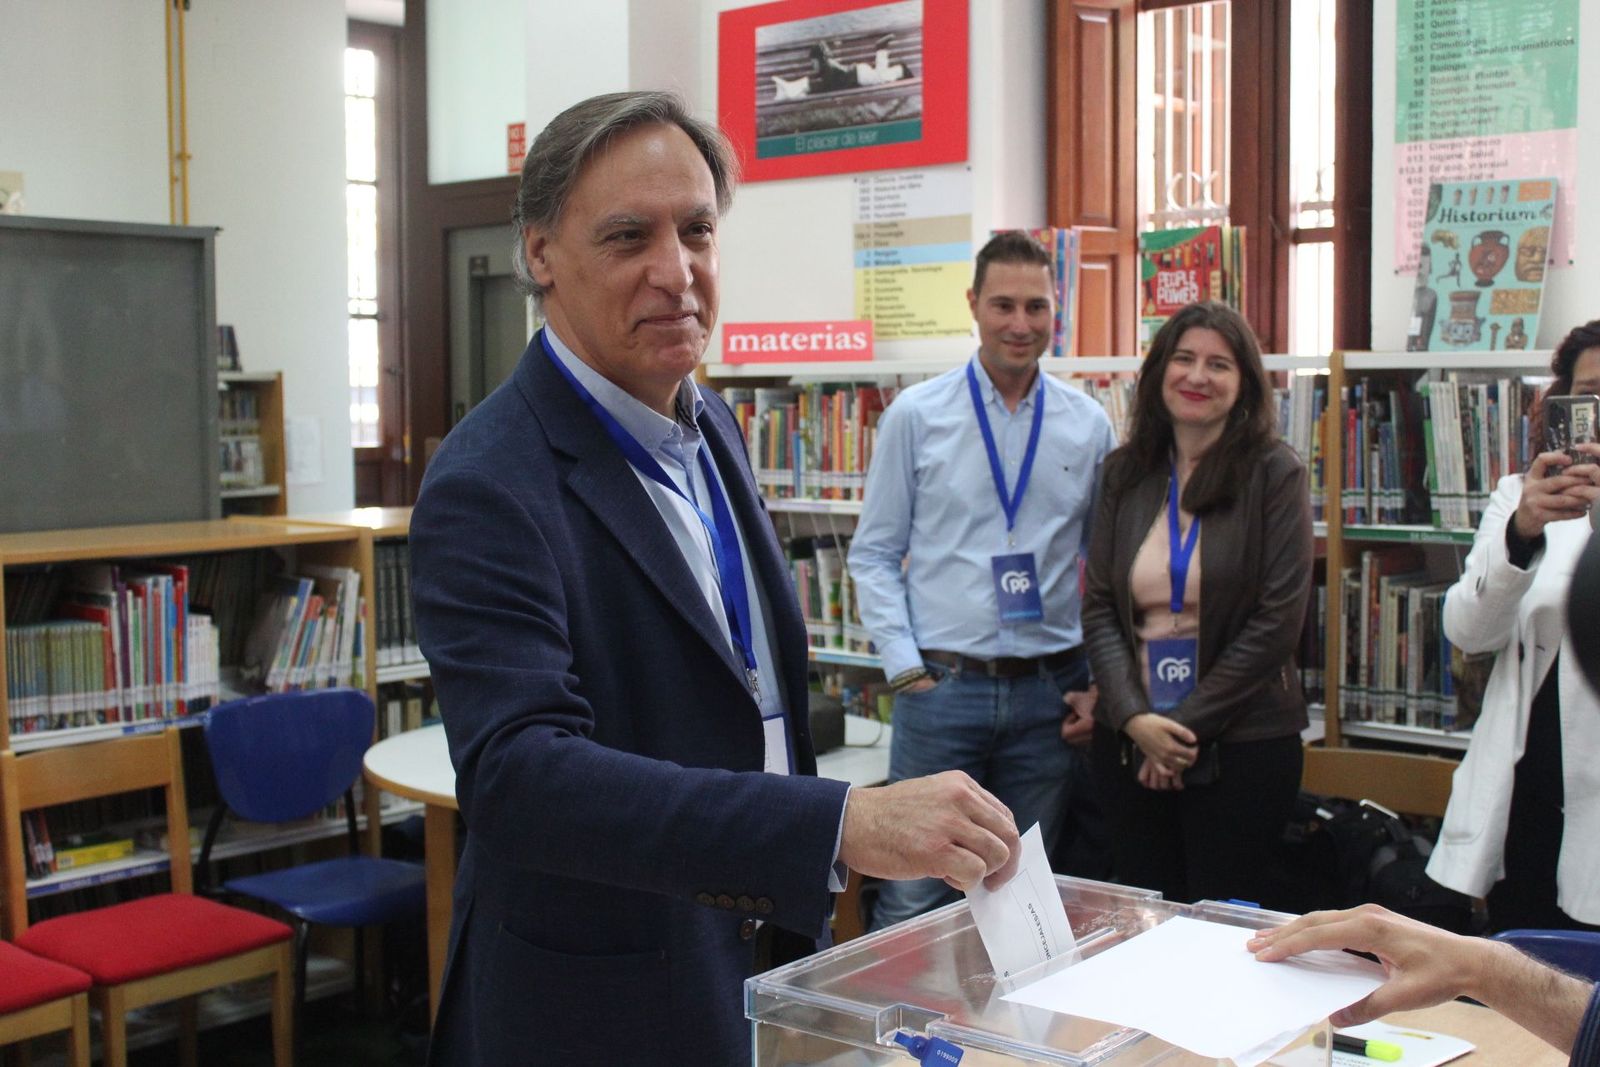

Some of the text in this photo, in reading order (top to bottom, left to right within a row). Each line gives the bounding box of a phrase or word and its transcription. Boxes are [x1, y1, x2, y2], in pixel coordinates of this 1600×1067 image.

[1437, 207, 1538, 224] Historium
[728, 325, 867, 352] materias
[1027, 902, 1052, 961] ONCEJALES/AS
